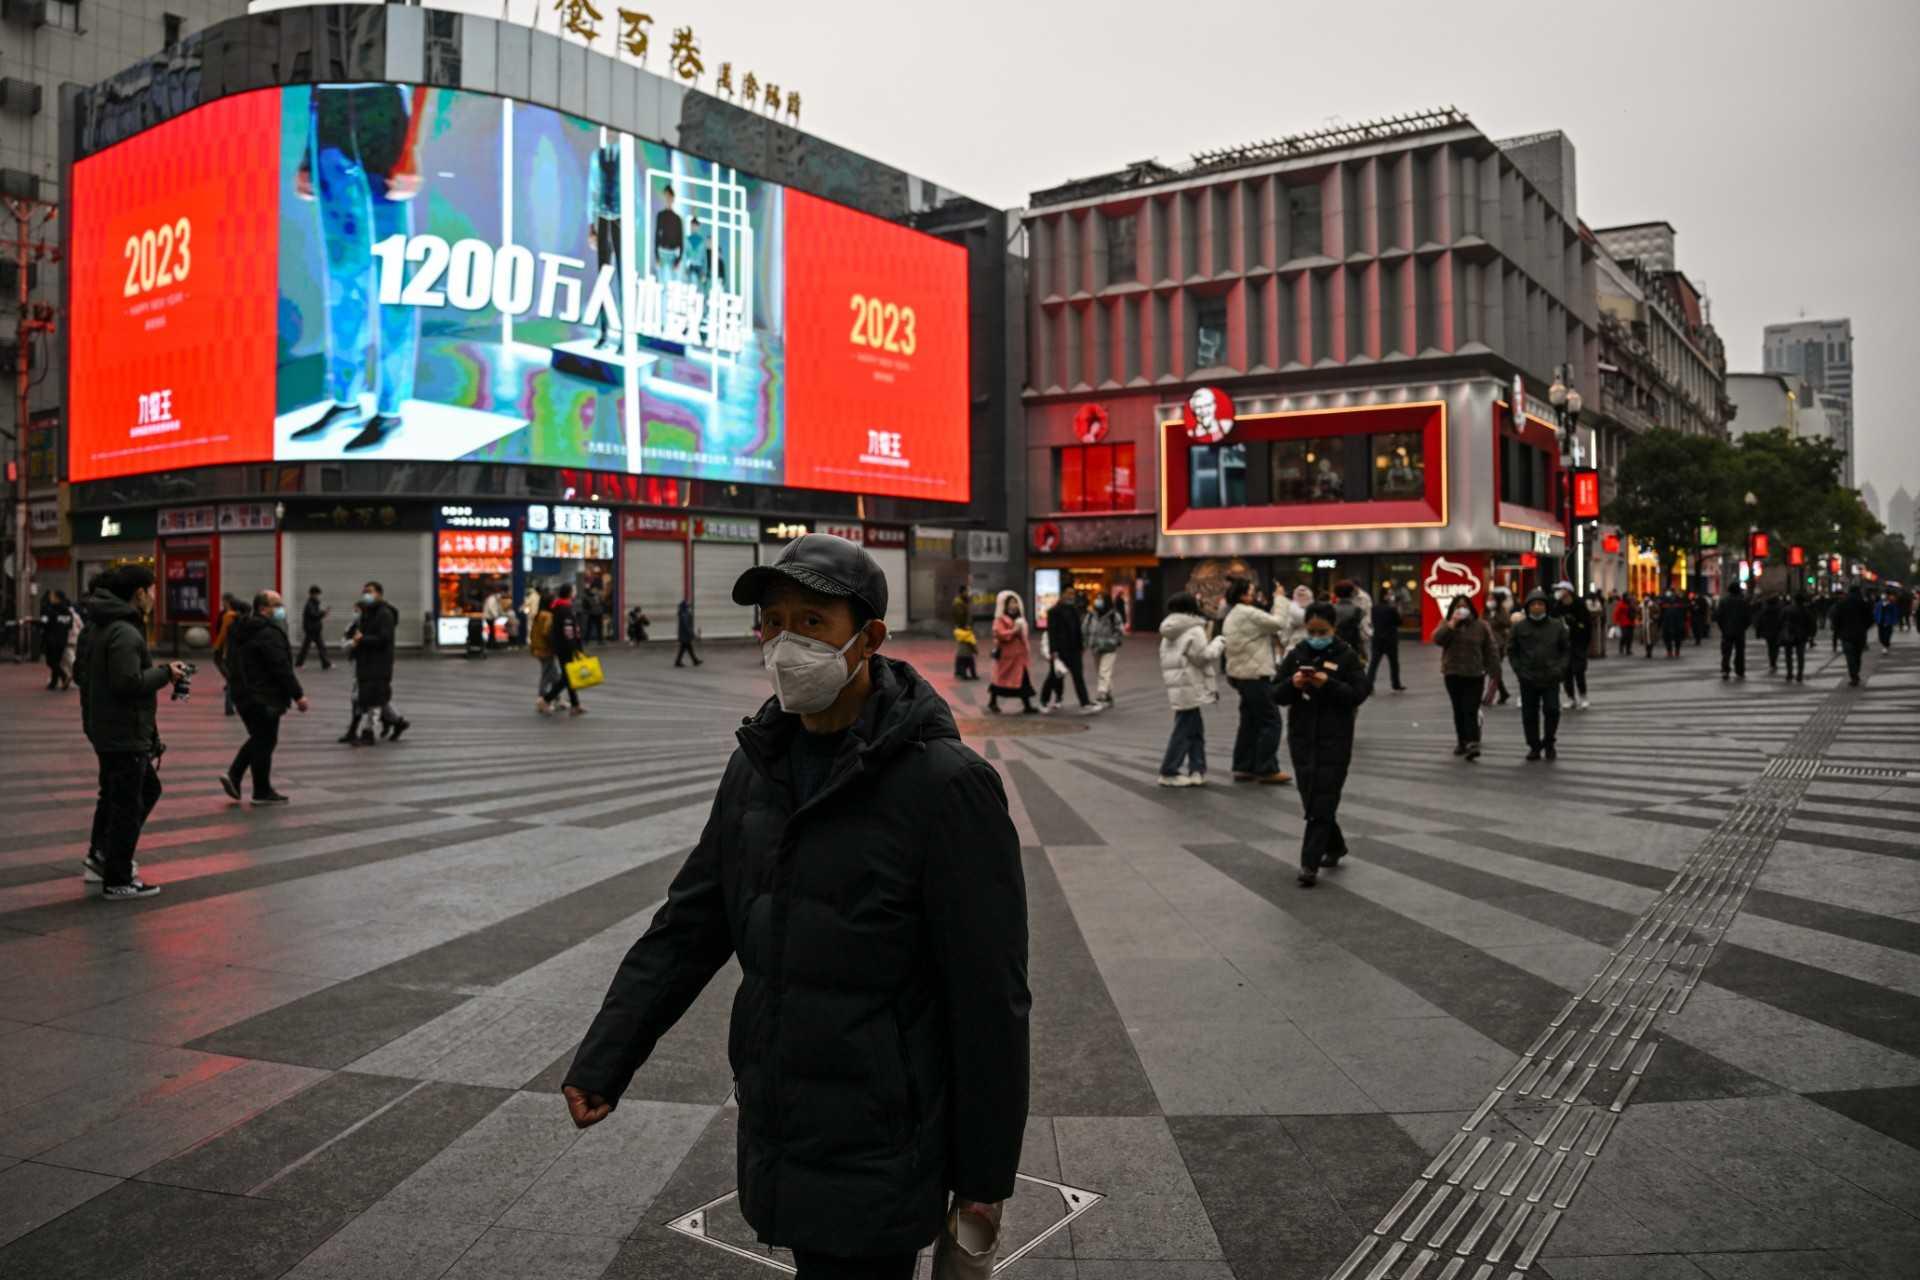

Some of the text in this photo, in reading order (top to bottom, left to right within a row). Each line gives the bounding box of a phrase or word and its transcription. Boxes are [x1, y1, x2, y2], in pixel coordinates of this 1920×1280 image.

[124, 216, 192, 298] 2023
[370, 233, 745, 354] 1200万人体数据
[850, 294, 916, 357] 2023
